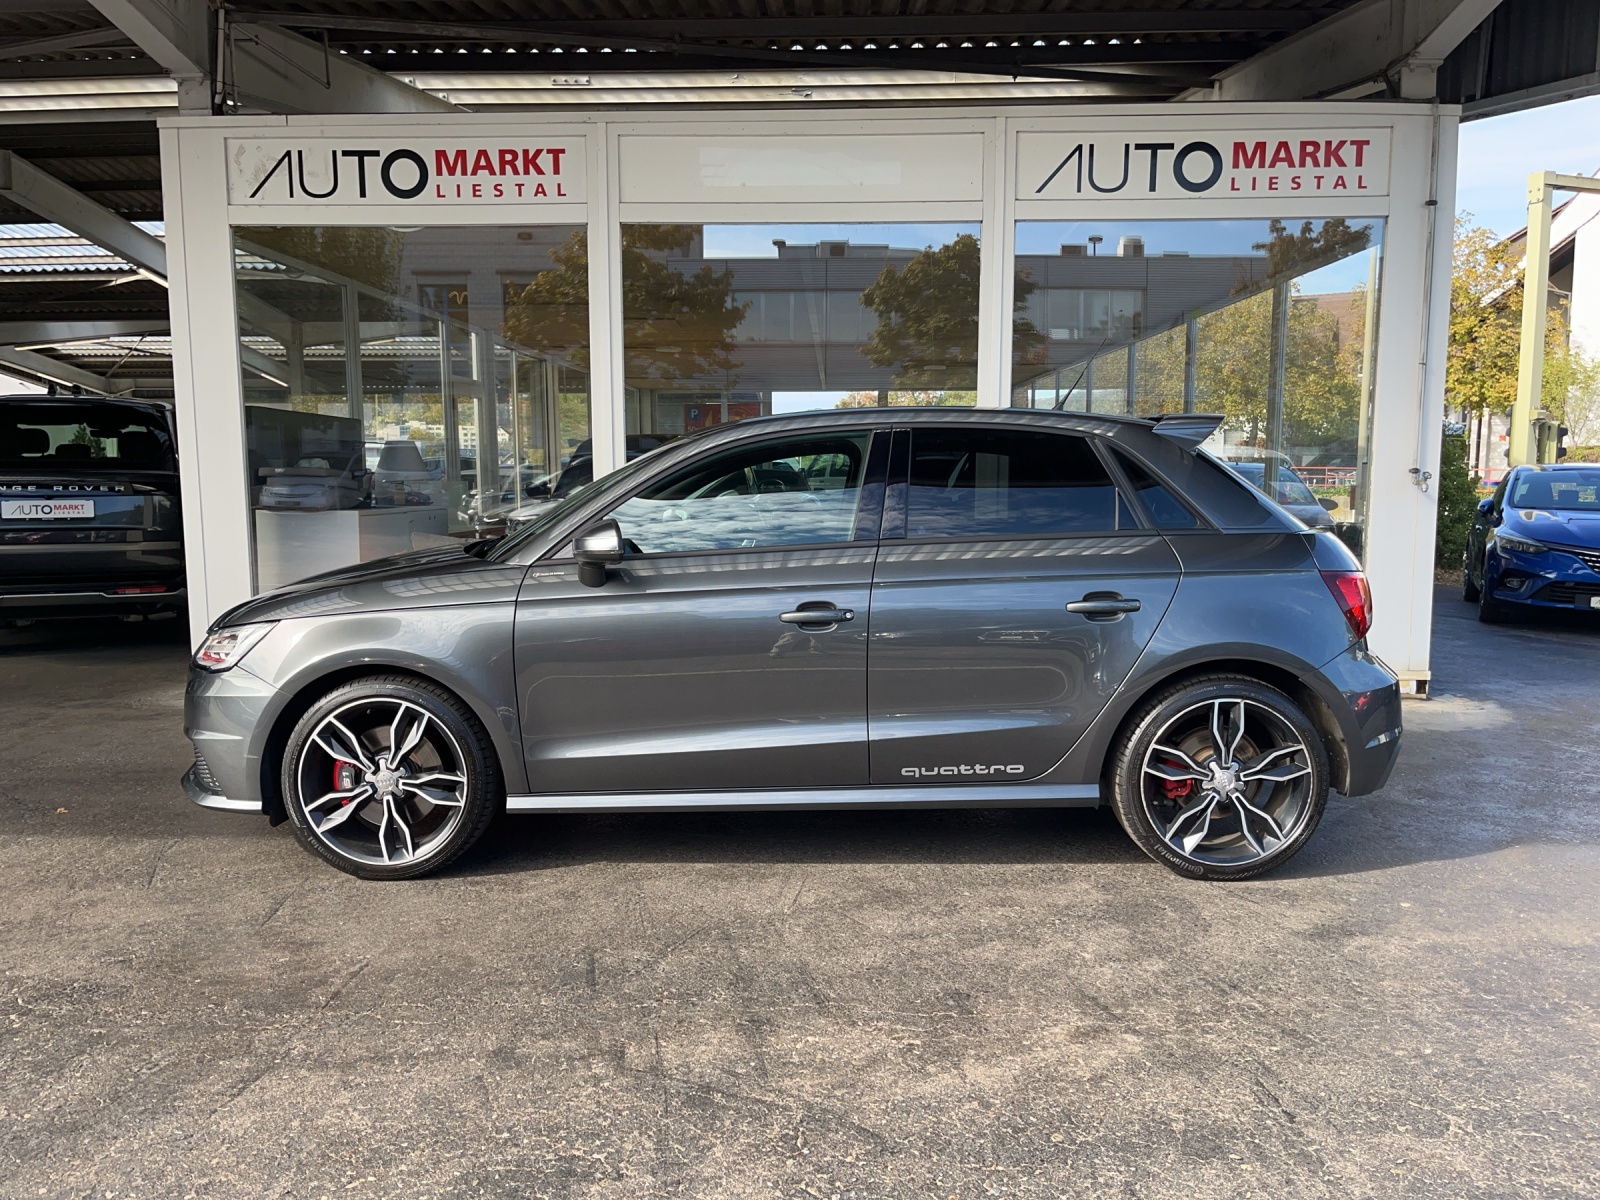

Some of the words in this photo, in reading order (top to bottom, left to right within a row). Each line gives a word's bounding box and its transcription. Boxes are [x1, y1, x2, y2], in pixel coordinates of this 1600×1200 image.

[249, 149, 429, 199] AUTO
[434, 148, 566, 176] MARKT
[1035, 141, 1223, 193] AUTO
[1231, 139, 1371, 169] MARKT
[436, 182, 567, 199] LIESTAL
[1230, 175, 1368, 191] LIESTAL
[691, 409, 699, 418] P
[10, 504, 53, 515] AUTO
[901, 764, 1025, 778] quattro
[342, 771, 352, 789] S1
[1153, 843, 1204, 875] Continental
